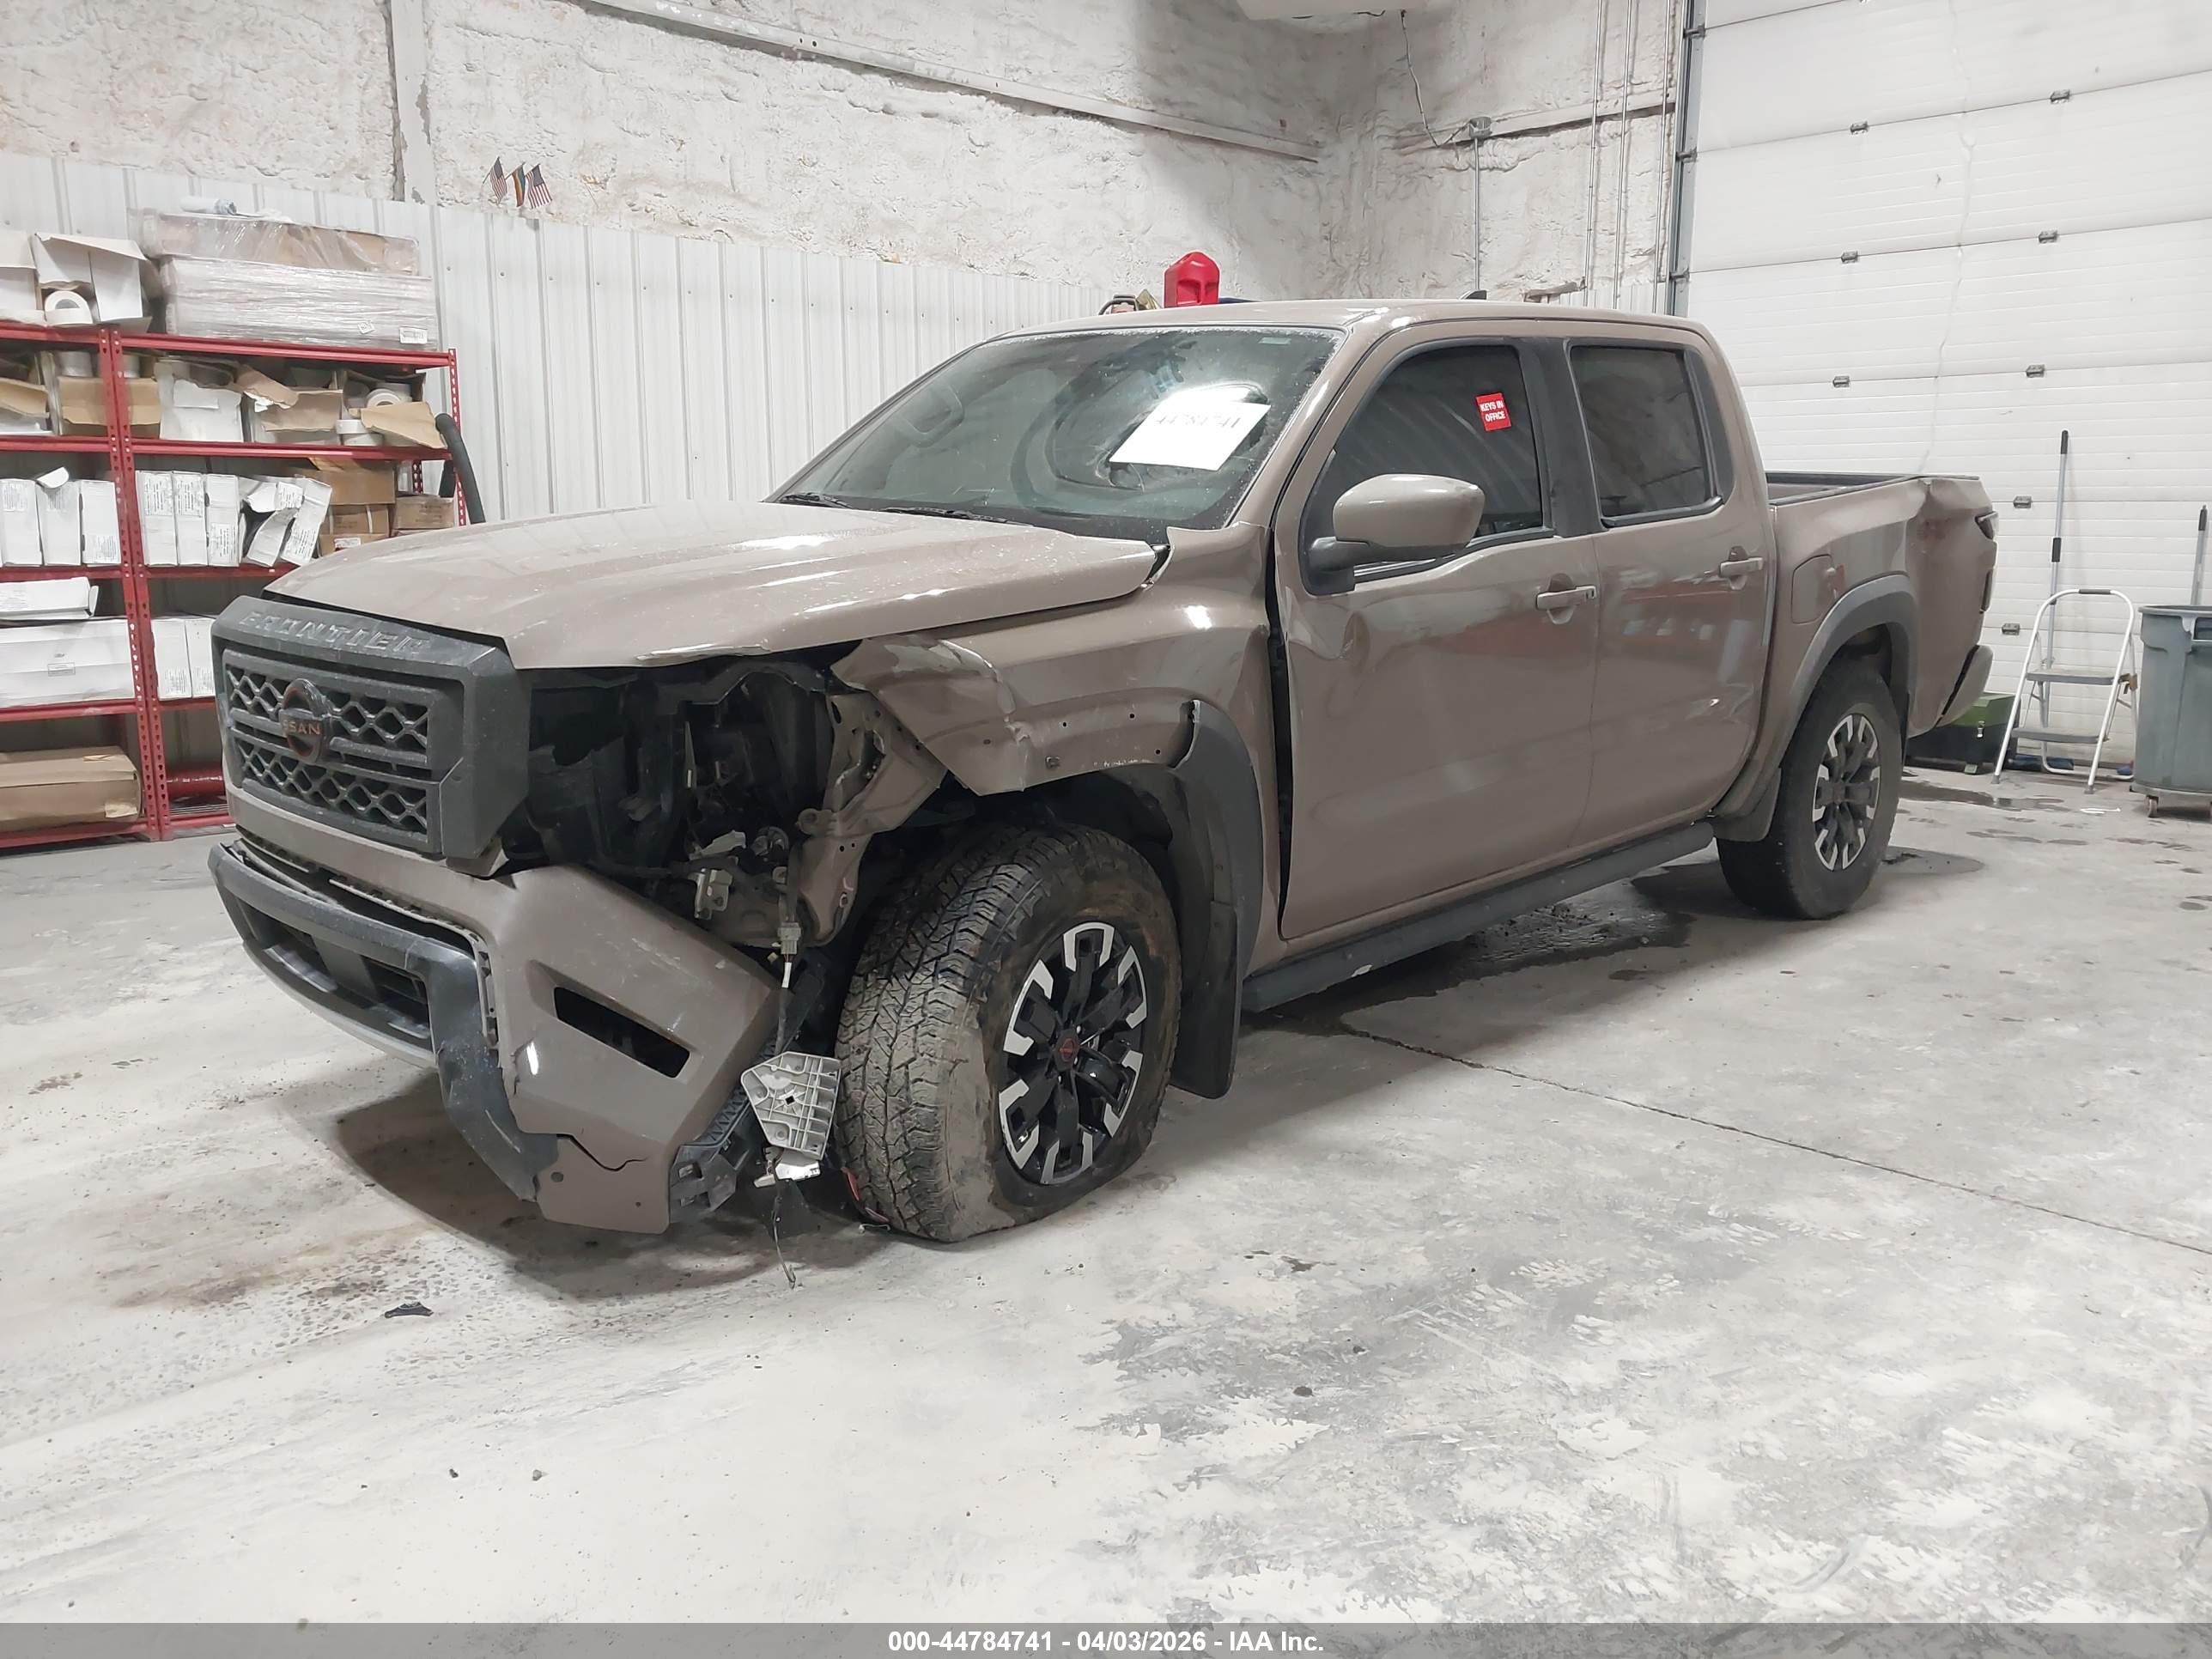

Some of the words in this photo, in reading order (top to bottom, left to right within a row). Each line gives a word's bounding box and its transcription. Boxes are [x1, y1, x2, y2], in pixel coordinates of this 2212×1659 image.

[1480, 402, 1496, 412] KEYS
[1496, 400, 1504, 409] IN
[1486, 411, 1506, 422] OFFICE
[239, 611, 429, 653] FRONTIER
